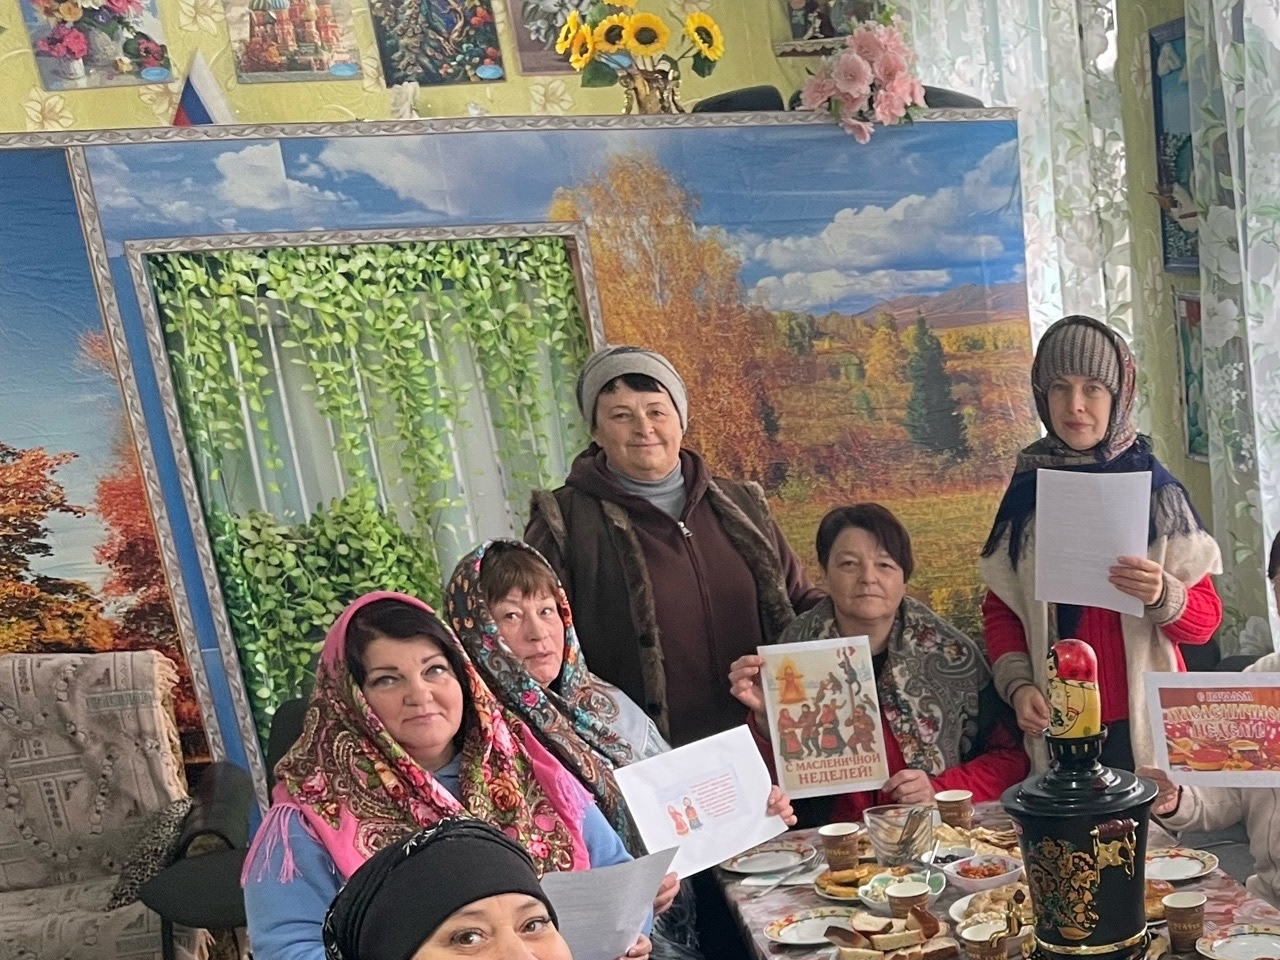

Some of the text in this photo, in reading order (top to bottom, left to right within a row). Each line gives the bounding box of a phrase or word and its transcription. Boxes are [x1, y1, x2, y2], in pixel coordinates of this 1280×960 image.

[785, 752, 881, 772] С МАСЛЕНИЧНОЙ
[799, 766, 873, 784] НЕДЕЛЕЙ!
